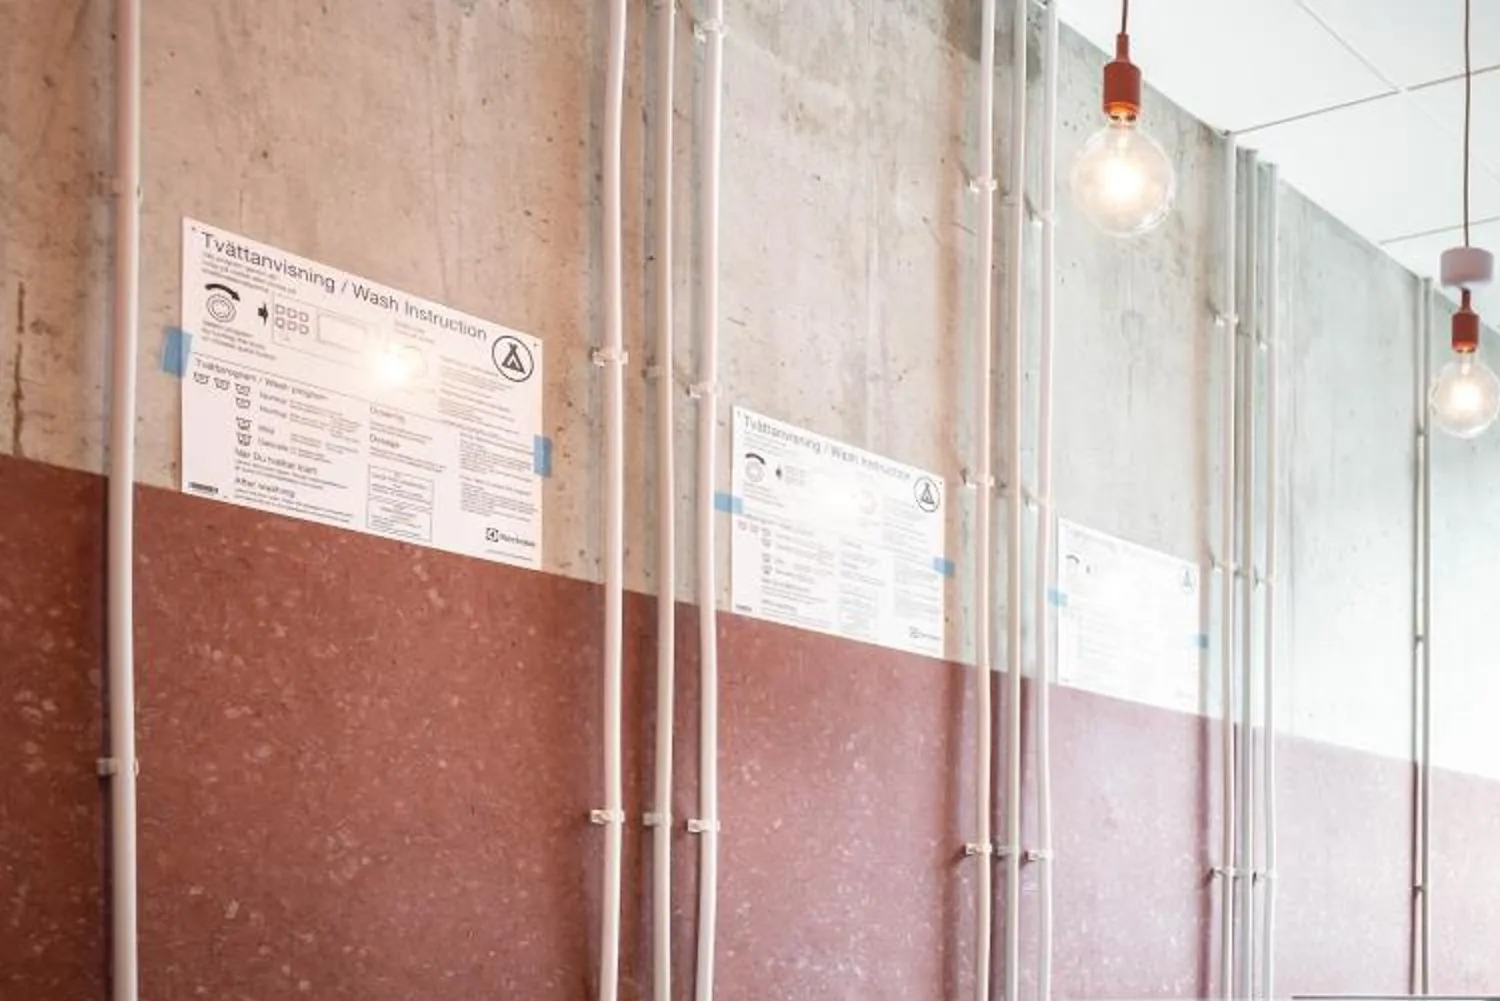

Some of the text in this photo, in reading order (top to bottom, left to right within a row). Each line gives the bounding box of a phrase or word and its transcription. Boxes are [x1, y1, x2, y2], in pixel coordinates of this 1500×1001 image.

[201, 231, 335, 293] Tvättanvisning
[352, 281, 399, 312] Wash
[405, 300, 487, 341] Instruction
